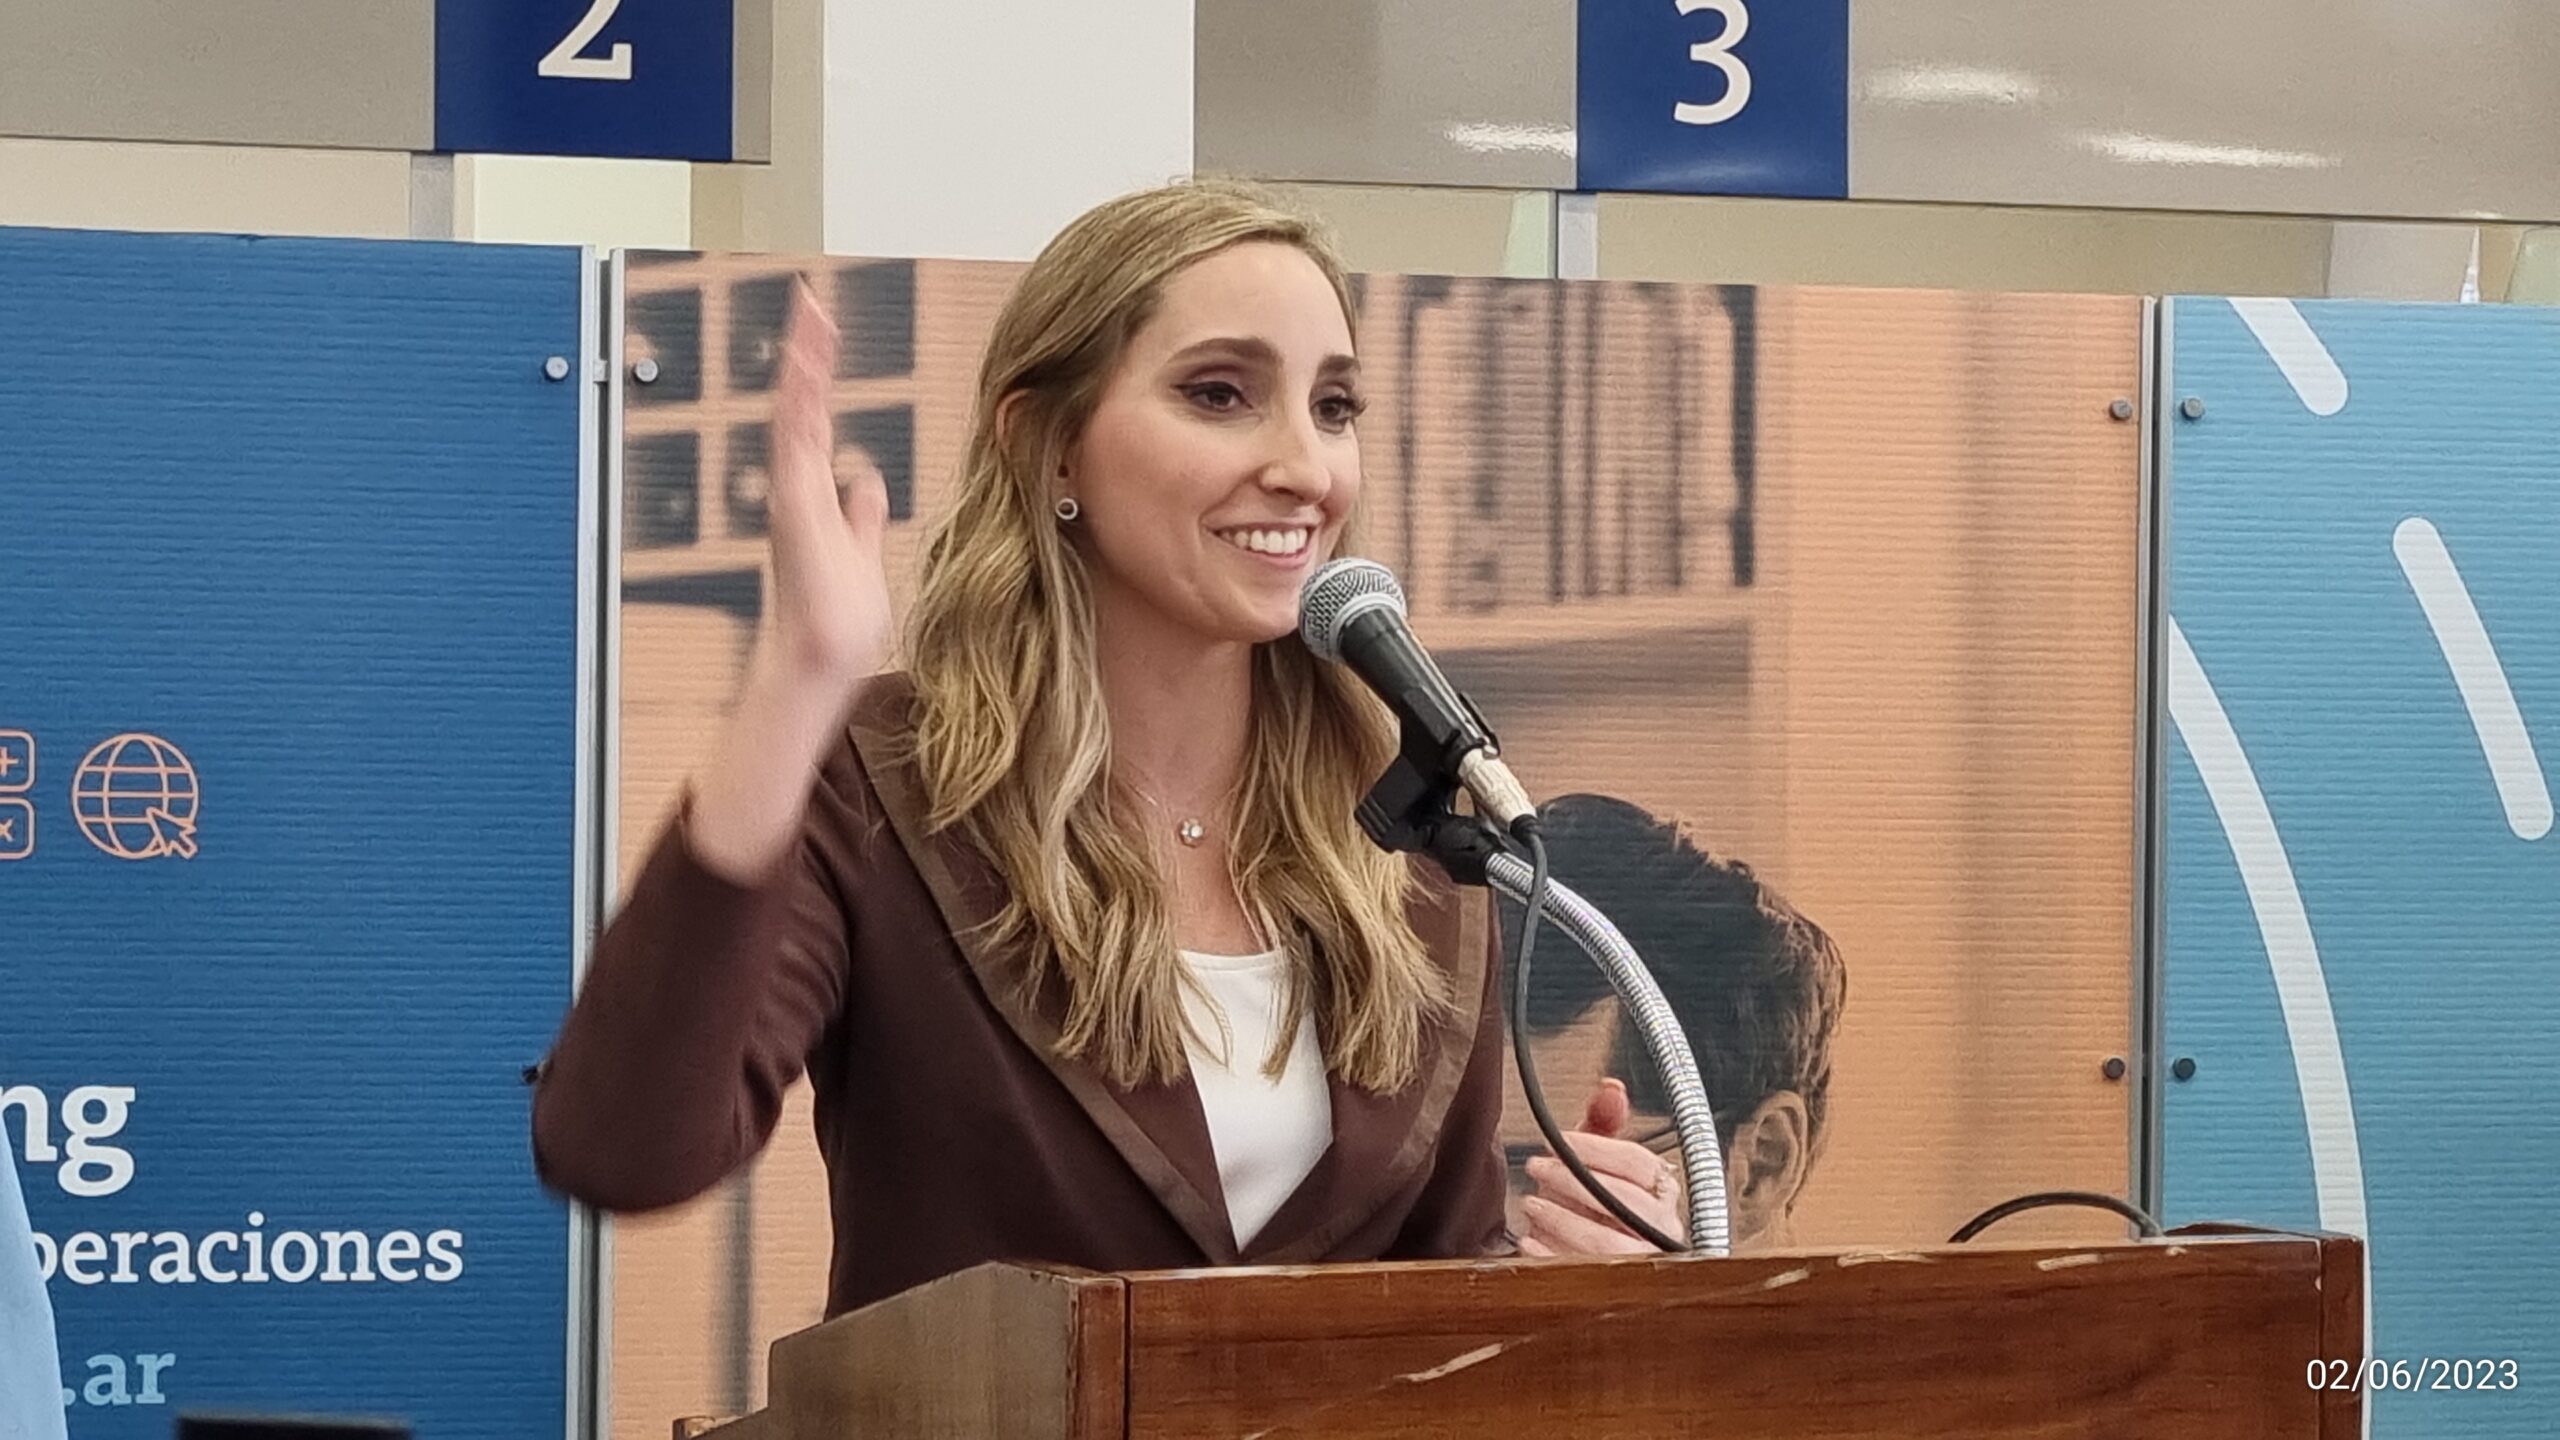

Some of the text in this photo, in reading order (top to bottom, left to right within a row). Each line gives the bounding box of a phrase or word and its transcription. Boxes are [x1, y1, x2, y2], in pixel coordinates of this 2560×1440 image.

[538, 0, 632, 80] 2
[1674, 0, 1751, 125] 3
[62, 1353, 176, 1406] .ar
